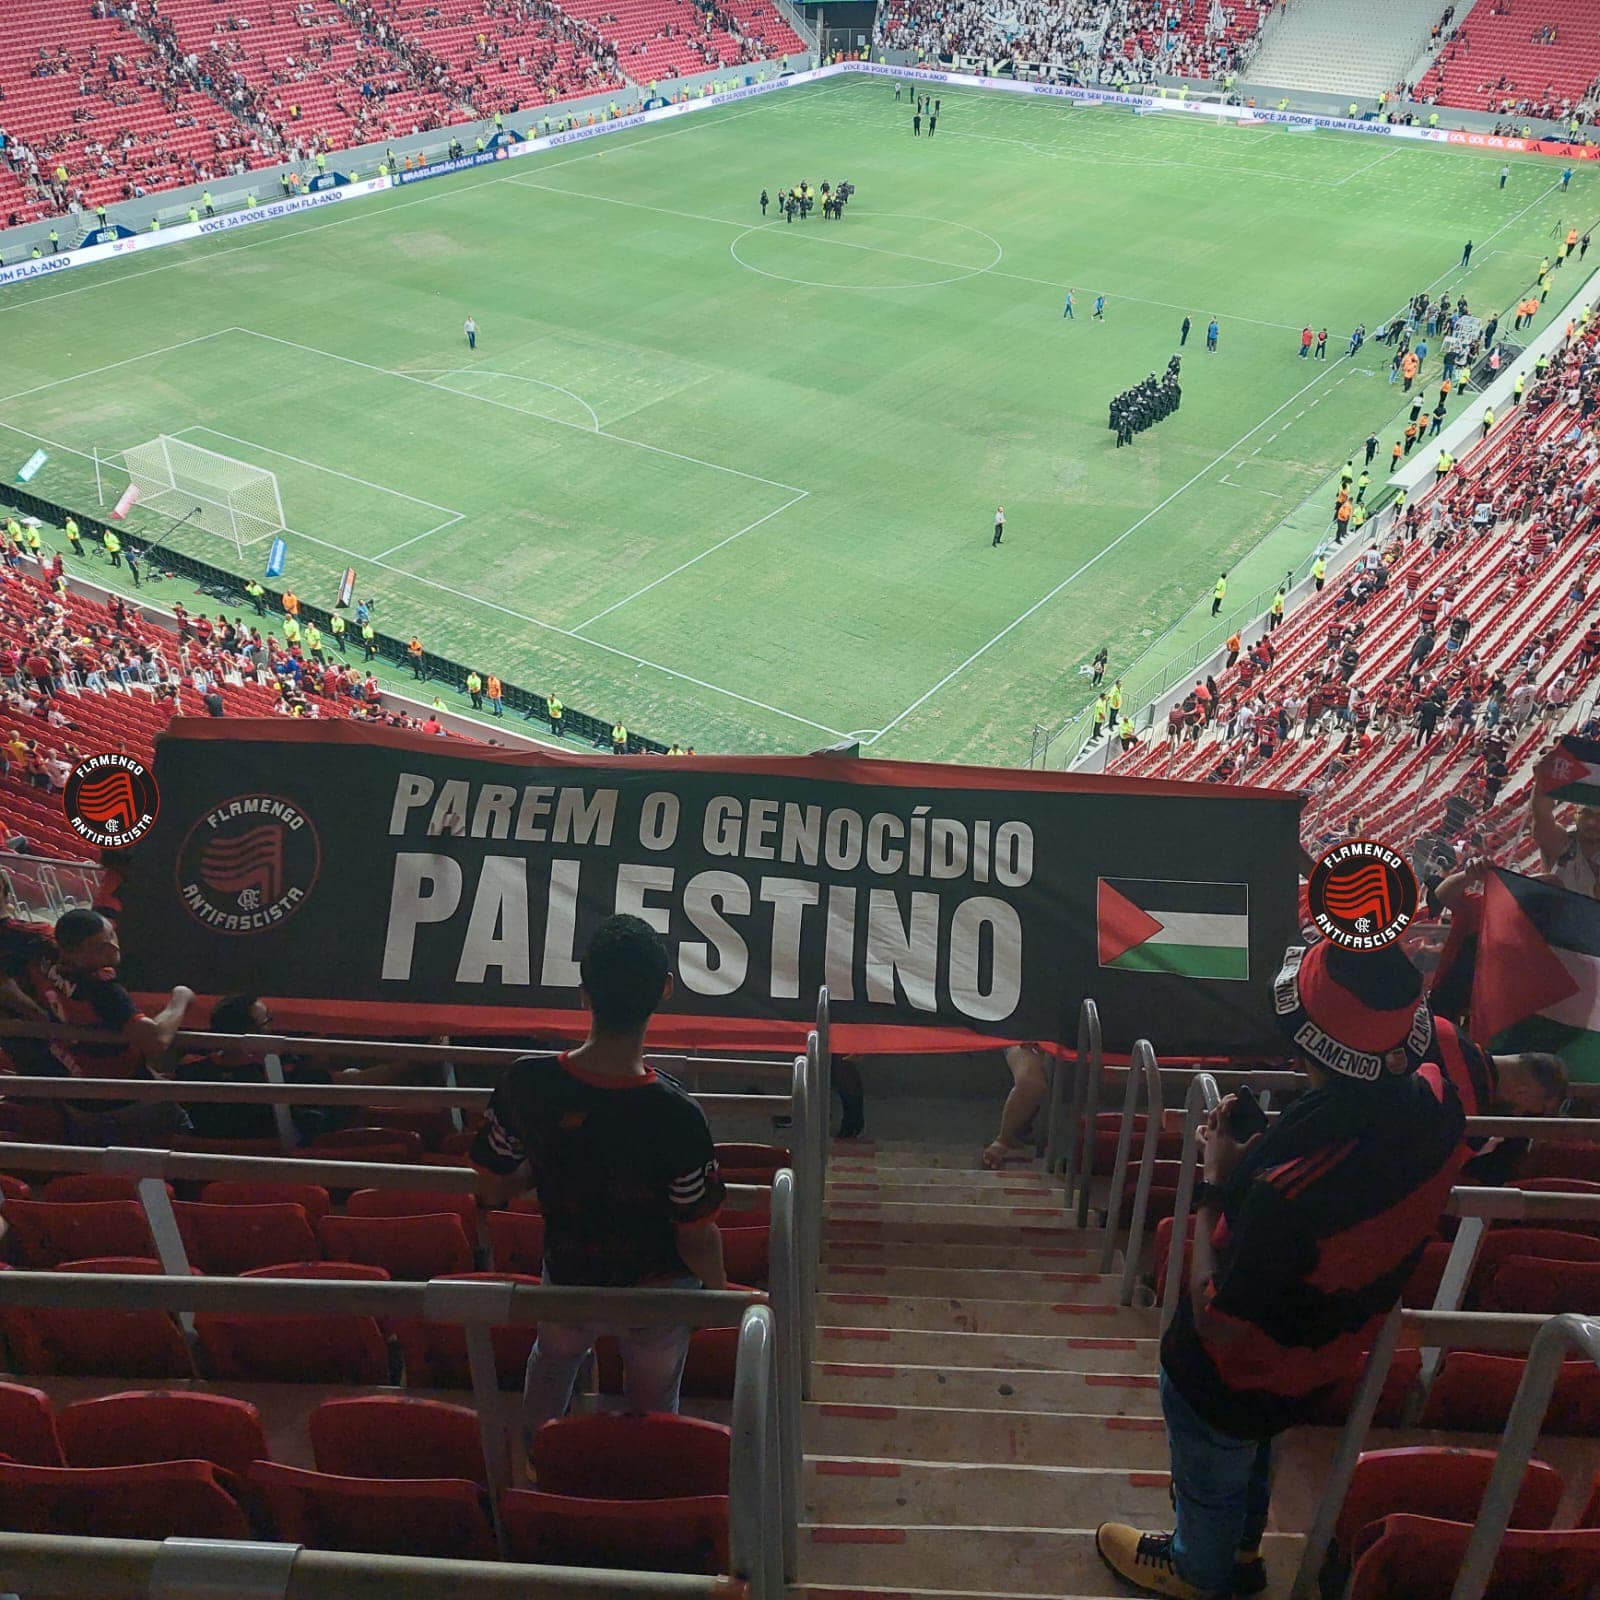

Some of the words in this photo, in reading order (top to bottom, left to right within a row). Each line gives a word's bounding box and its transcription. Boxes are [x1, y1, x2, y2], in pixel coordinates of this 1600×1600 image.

[1289, 115, 1313, 125] PODE
[1314, 118, 1330, 127] SER
[1332, 120, 1347, 129] UM
[240, 205, 267, 224] PODE
[268, 203, 285, 217] SER
[286, 200, 301, 213] UM
[16, 256, 71, 279] FLA-ANJO
[206, 798, 305, 831] FLAMENGO
[389, 772, 619, 847] PAREM
[639, 791, 681, 851] O
[702, 795, 1035, 888] GENOCÍDIO
[182, 883, 305, 930] ANTIFASCISTA
[1297, 1022, 1380, 1078] FLAMENGO
